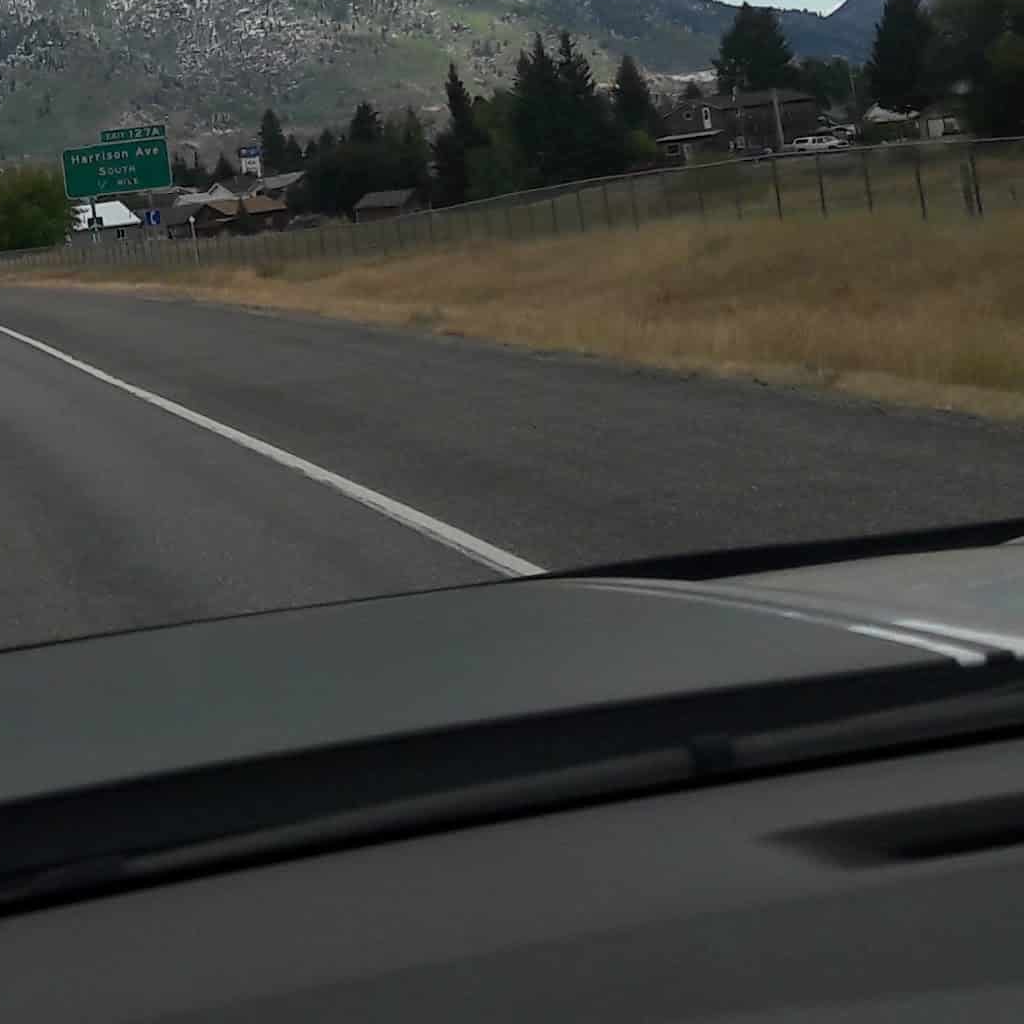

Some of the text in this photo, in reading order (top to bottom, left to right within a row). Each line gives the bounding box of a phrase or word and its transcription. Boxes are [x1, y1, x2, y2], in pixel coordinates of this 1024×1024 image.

[128, 127, 160, 138] 127A
[71, 146, 160, 165] Harrison Ave
[98, 165, 136, 176] SOUTH
